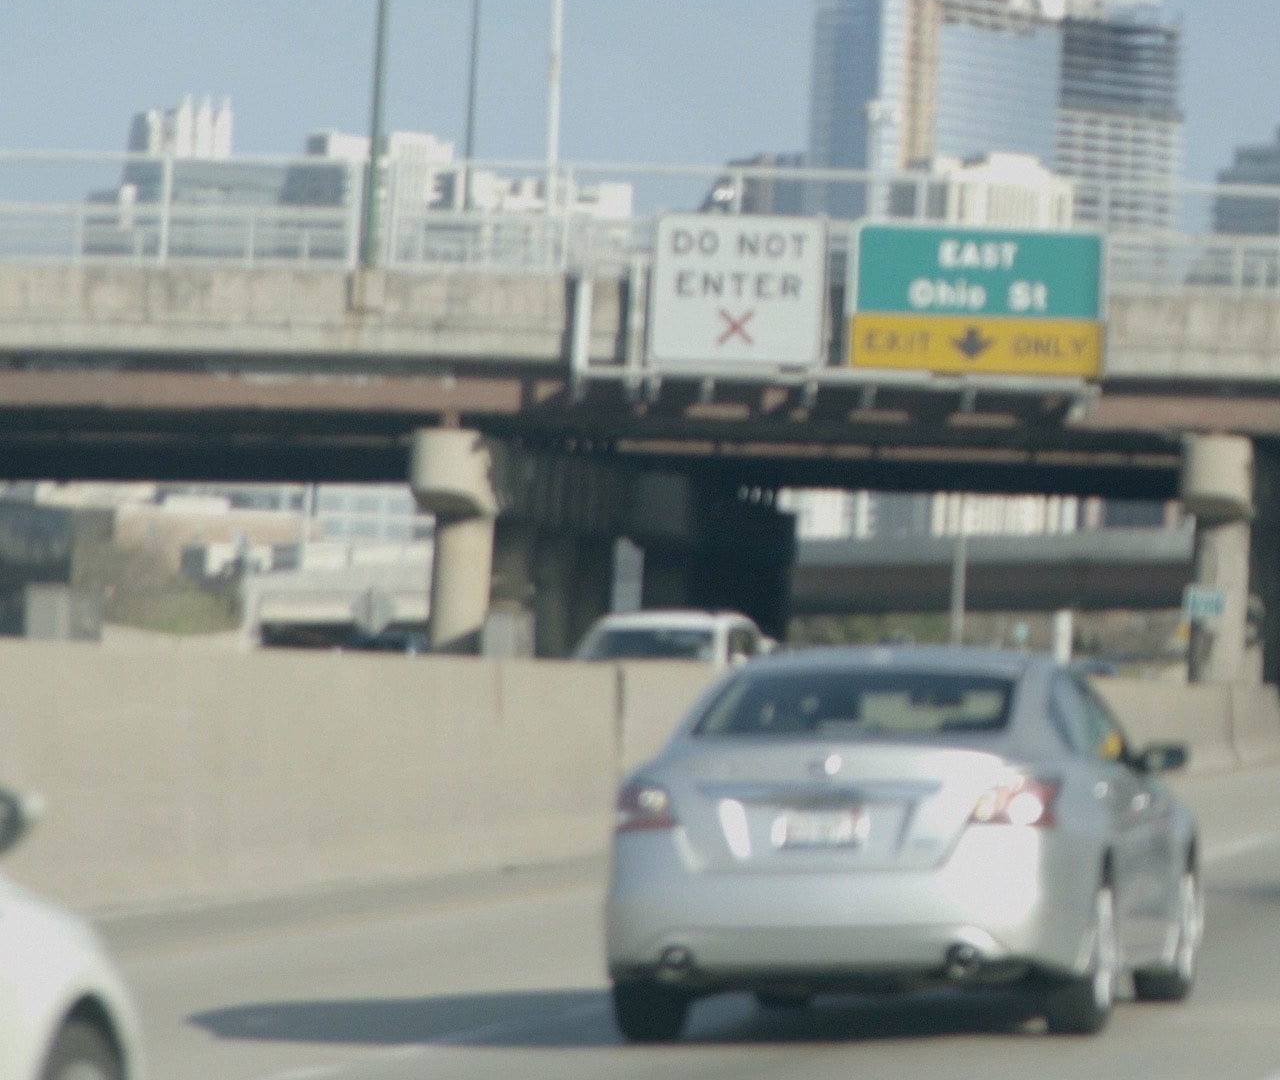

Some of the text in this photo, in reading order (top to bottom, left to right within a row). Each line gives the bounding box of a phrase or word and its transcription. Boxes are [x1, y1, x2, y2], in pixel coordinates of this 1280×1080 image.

[672, 230, 808, 259] DO NOT
[938, 239, 1018, 269] EAST
[675, 271, 802, 299] ENTER
[909, 278, 1047, 312] Ohio St
[863, 328, 1089, 358] EXIT ONLY
